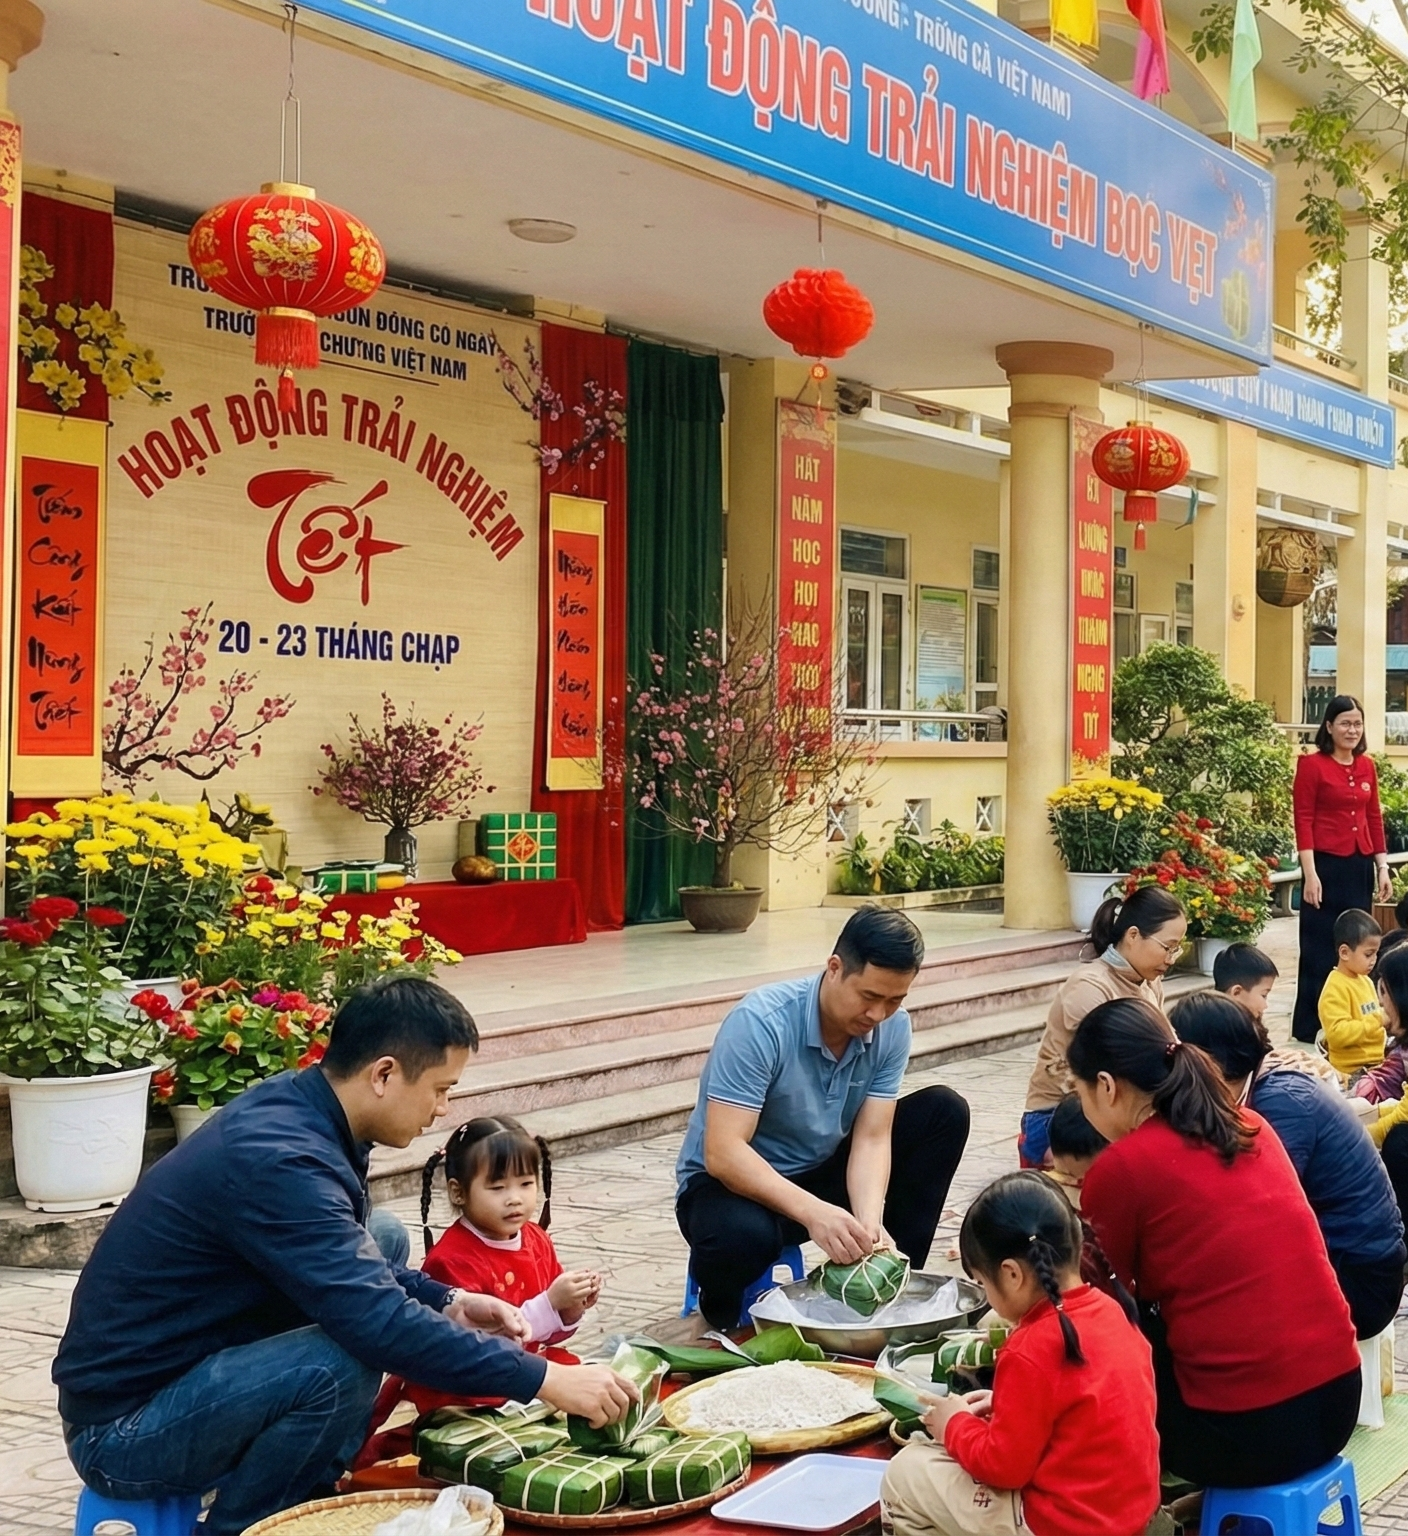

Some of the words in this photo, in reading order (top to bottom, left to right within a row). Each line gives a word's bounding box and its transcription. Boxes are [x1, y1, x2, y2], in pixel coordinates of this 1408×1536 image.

[914, 10, 967, 66] TRỐNG
[997, 55, 1028, 98] VIỆT
[1031, 77, 1071, 121] NAM)
[526, 0, 693, 83] ẠT
[706, 0, 850, 143] ĐỘNG
[862, 64, 956, 188] TRẢI
[965, 113, 1098, 248] NGHIỆM
[1104, 181, 1161, 277] BỌC
[1165, 210, 1218, 305] VẸT
[390, 346, 426, 374] VIỆT
[431, 355, 467, 381] NAM
[117, 403, 222, 499] HOẠT
[224, 378, 328, 450] ĐỘNG
[341, 393, 416, 464] TRẢI
[415, 432, 526, 562] NGHIỆM
[247, 468, 411, 606] Tết
[792, 538, 820, 569] HỌC
[218, 619, 251, 654] 20
[276, 622, 307, 657] 23
[315, 621, 393, 662] THÁNG
[401, 631, 460, 672] CHẠP
